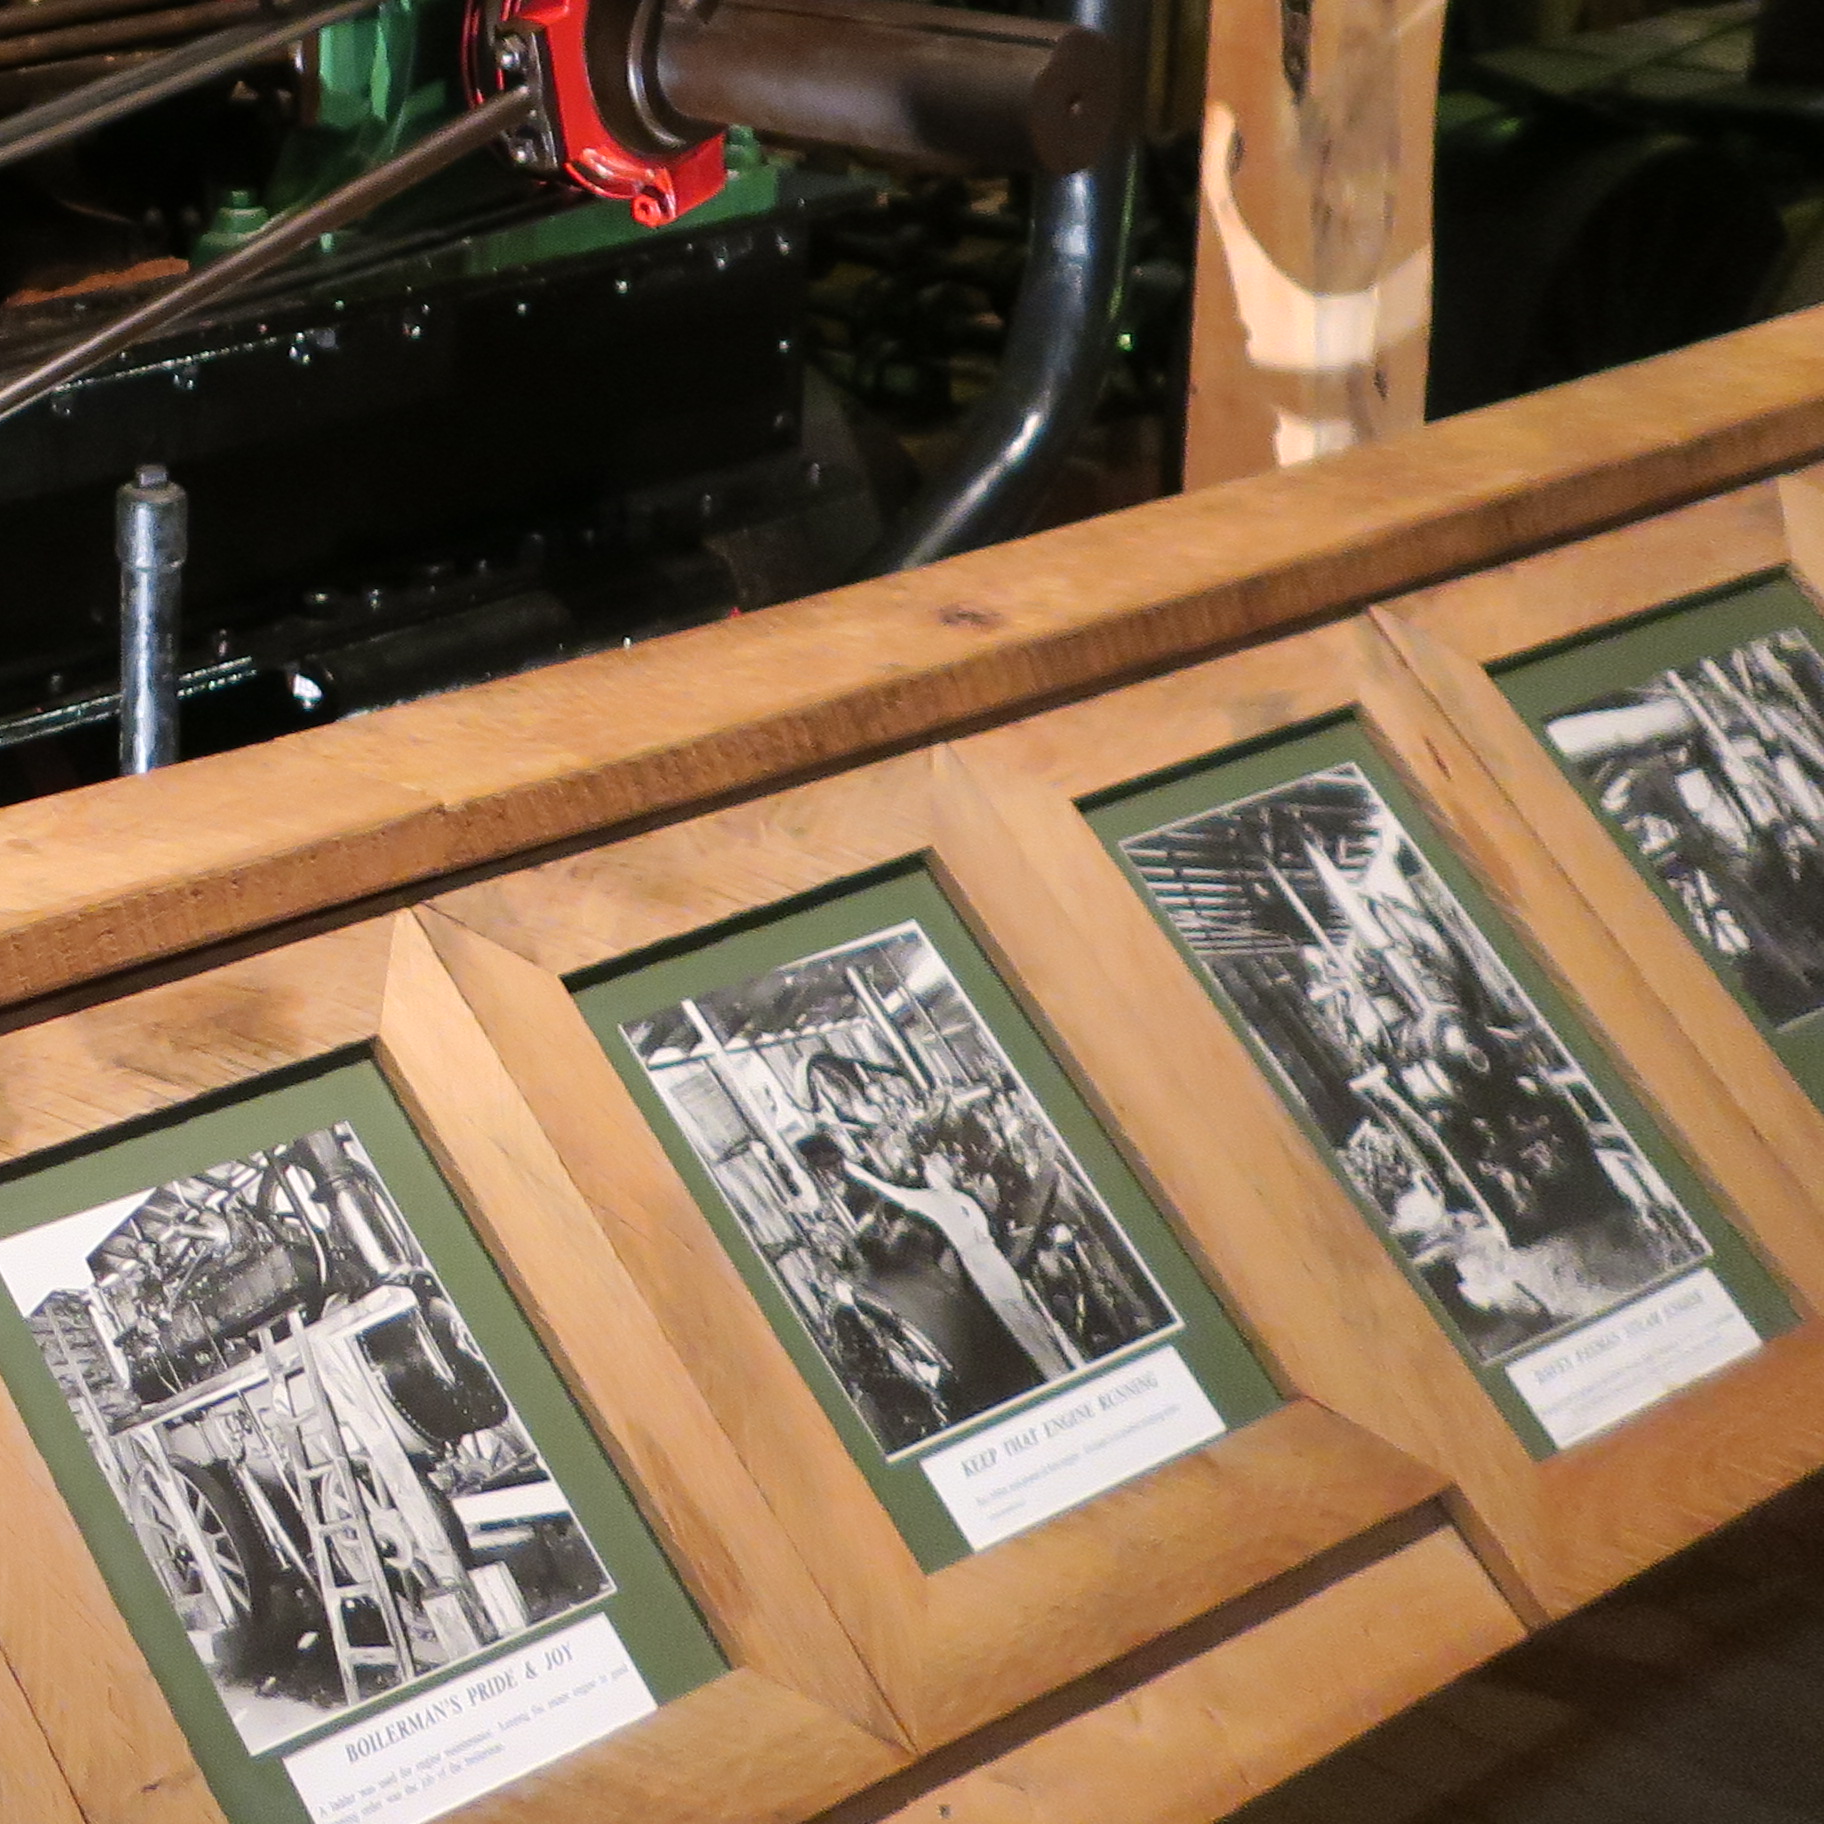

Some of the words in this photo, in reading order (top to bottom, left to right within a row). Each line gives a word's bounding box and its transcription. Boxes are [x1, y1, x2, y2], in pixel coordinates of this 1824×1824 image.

[961, 1448, 996, 1477] KEEP
[1003, 1428, 1038, 1456] THAT
[1043, 1404, 1095, 1438] ENGINE
[1098, 1372, 1158, 1411] RUNNING
[345, 1696, 462, 1763] BOILERMAN'S
[467, 1669, 517, 1706] PRIDE
[525, 1661, 537, 1679] &
[545, 1643, 572, 1670] JOY
